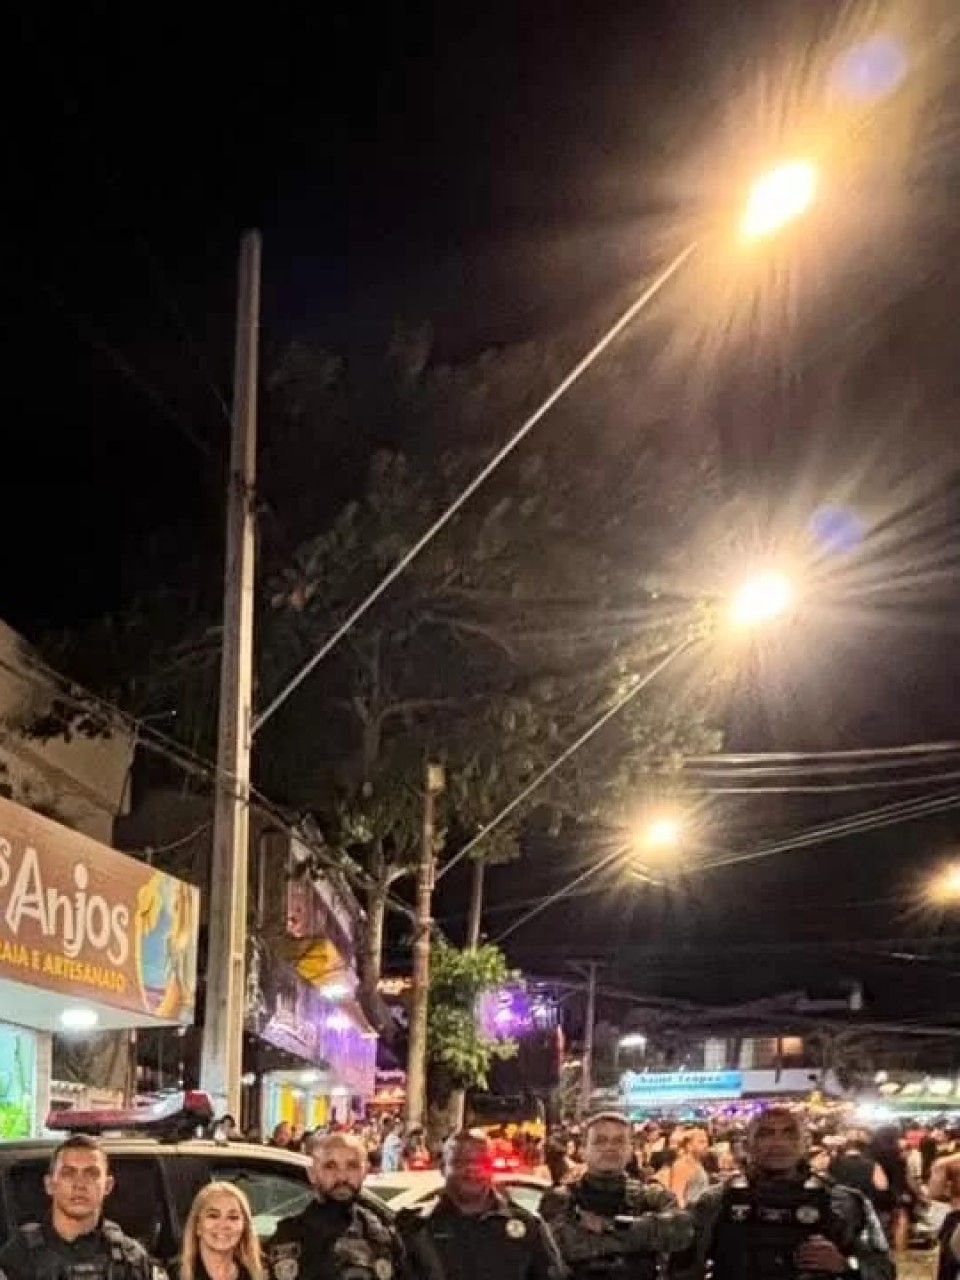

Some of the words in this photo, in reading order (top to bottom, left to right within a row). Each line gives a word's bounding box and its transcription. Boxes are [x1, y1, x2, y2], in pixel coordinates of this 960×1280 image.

[4, 846, 129, 966] Anjos
[31, 949, 41, 970] E
[42, 954, 126, 994] ARTESANATO
